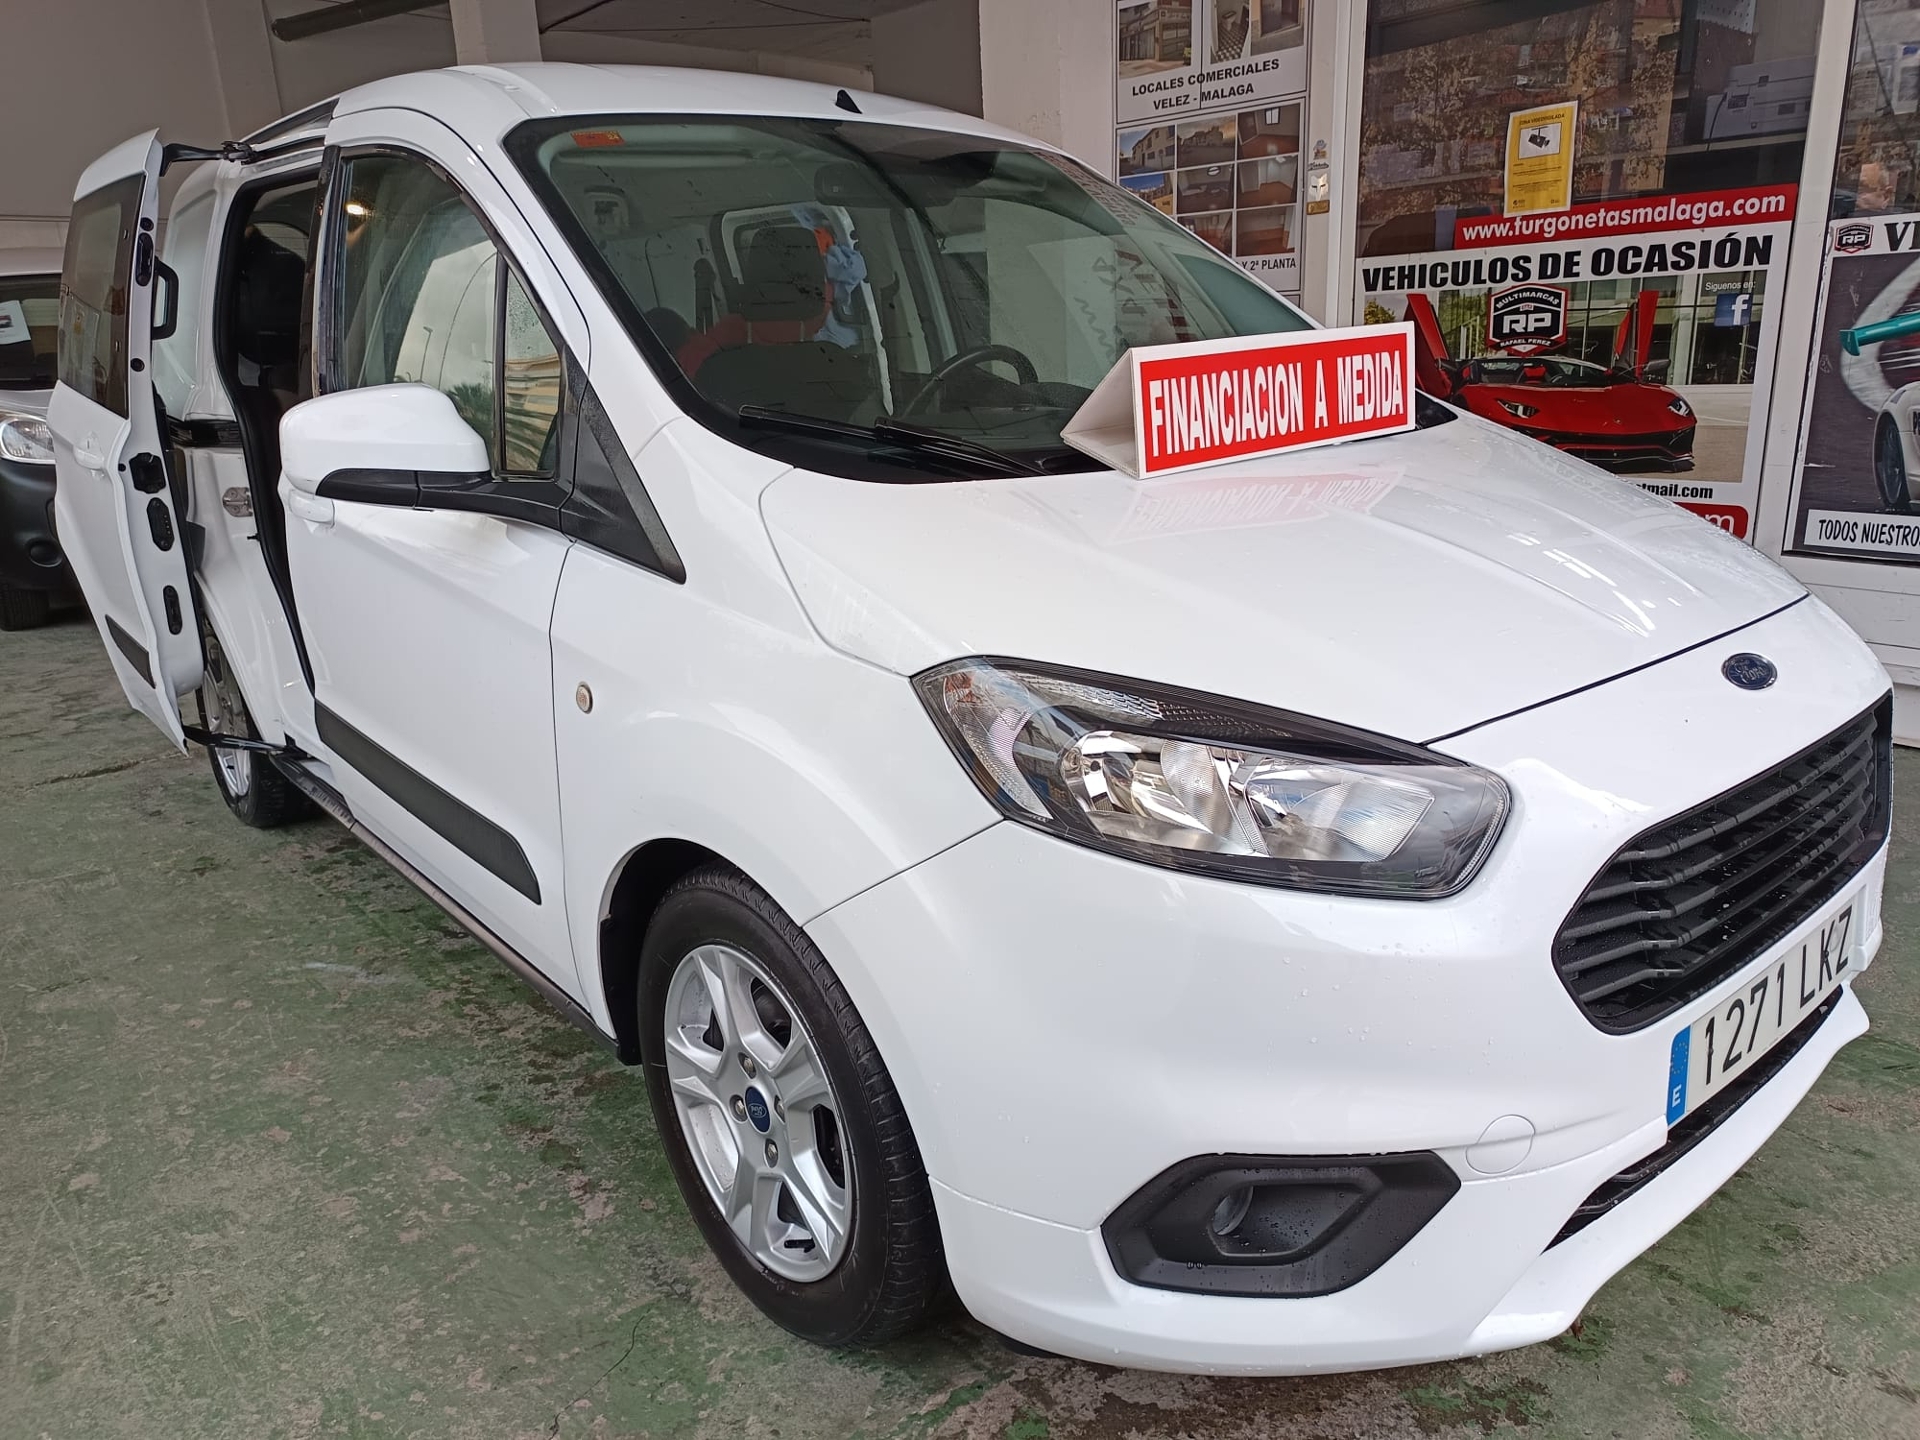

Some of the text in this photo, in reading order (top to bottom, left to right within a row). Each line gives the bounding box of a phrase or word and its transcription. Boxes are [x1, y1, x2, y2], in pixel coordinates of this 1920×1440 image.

[1132, 58, 1280, 96] LOCALES COMERCIALES
[1153, 94, 1190, 110] VELEZ
[1201, 83, 1254, 102] MALAGA
[1462, 194, 1785, 241] www.furgonetasmalaga.com
[1261, 258, 1297, 270] PLANTA
[1362, 231, 1774, 292] VEHICULOS DE OCASIÓN
[1495, 291, 1560, 309] MULTIMARCAS
[1502, 312, 1552, 334] RP
[1500, 338, 1552, 347] RAFAEL PEREZ
[1148, 350, 1405, 457] FINANCIACION A MEDIDA
[1818, 519, 1920, 547] TODOS NUESTRO
[1705, 904, 1853, 1086] 1271 LKZ
[1671, 1085, 1681, 1107] E
